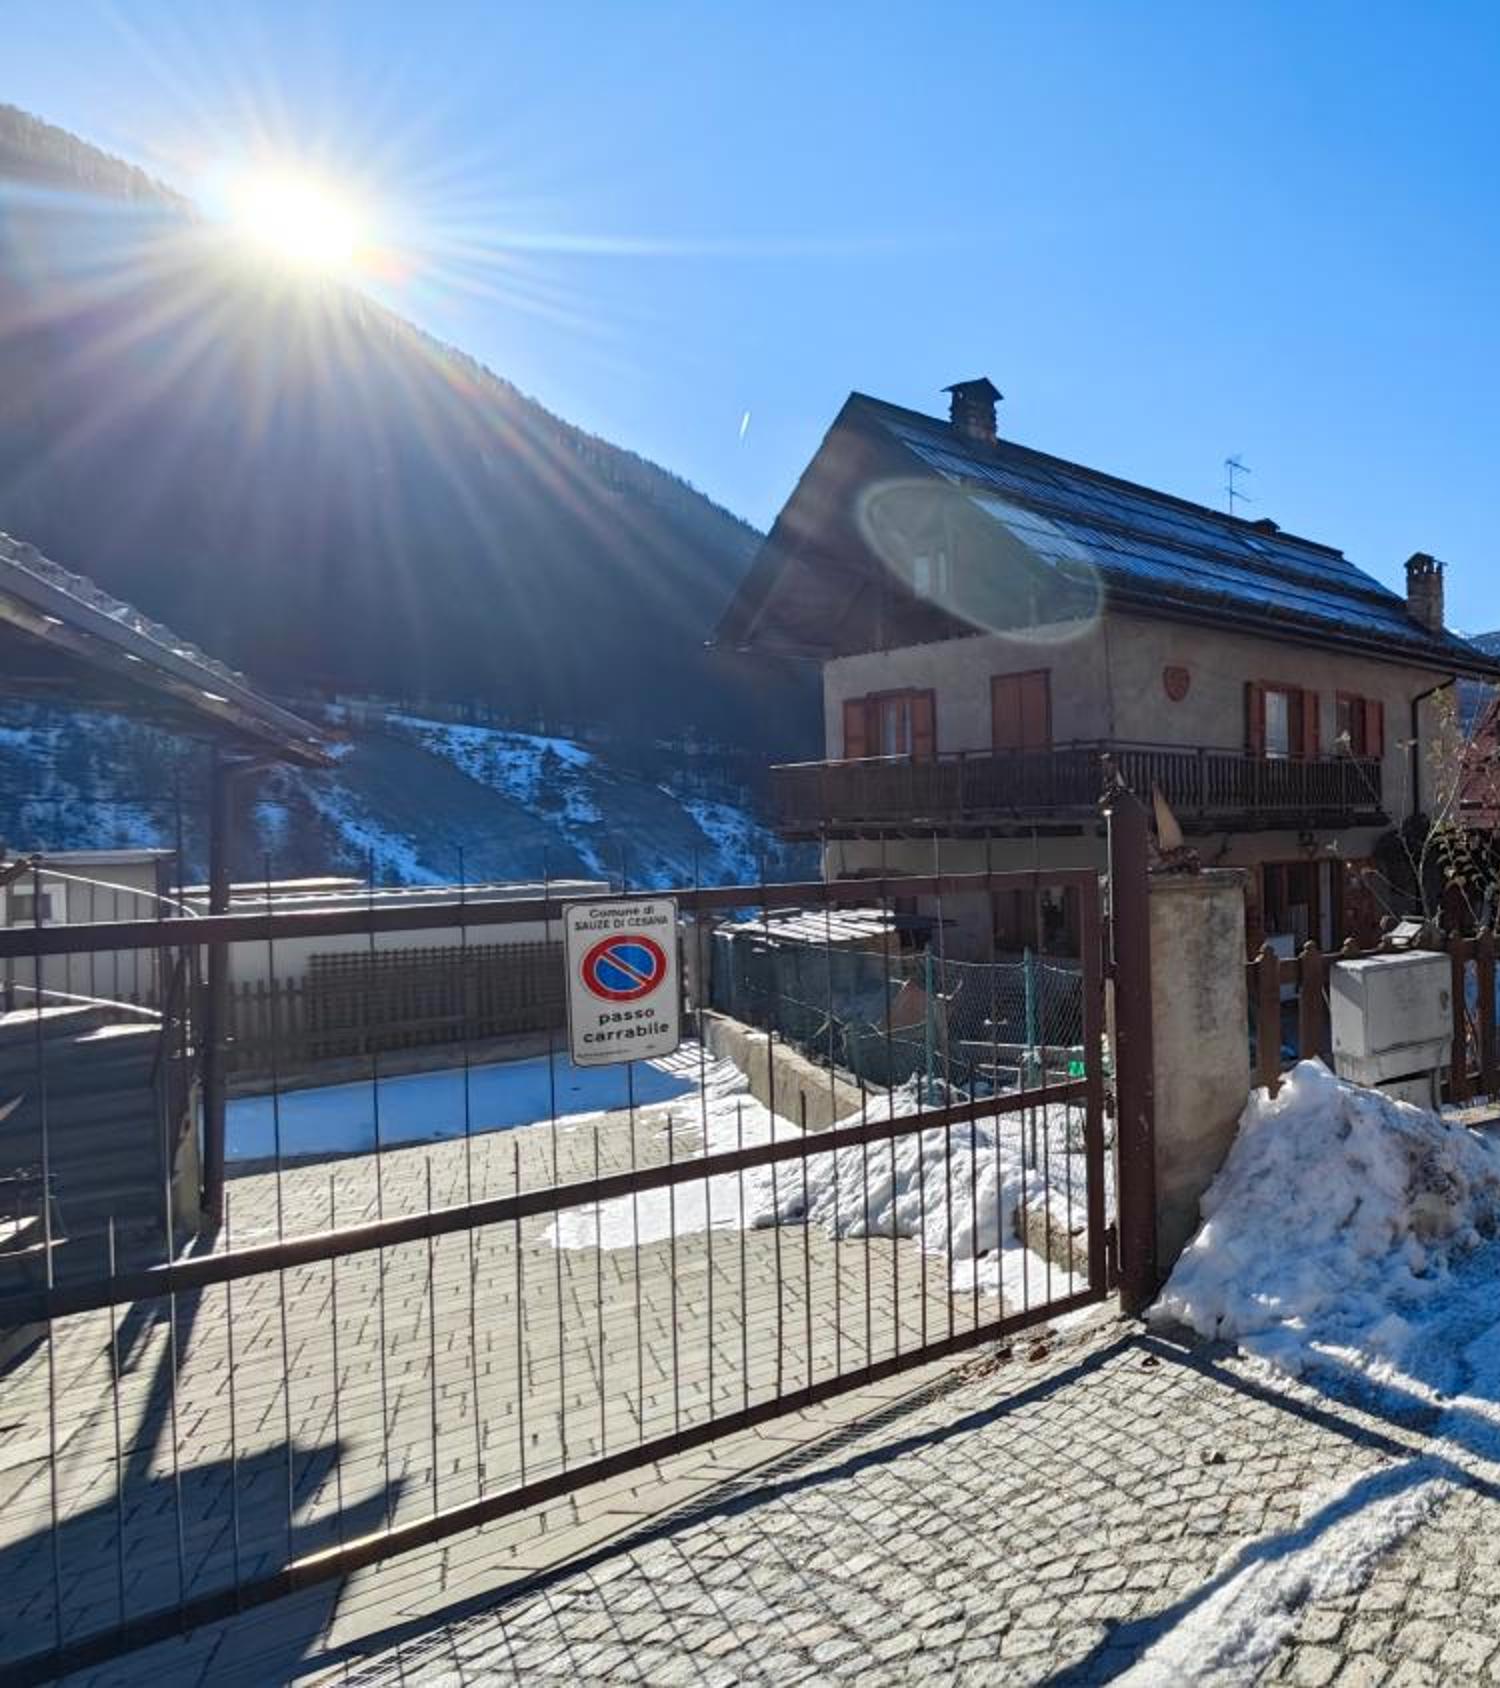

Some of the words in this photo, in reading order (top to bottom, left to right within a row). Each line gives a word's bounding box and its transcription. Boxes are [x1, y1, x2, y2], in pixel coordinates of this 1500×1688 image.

[589, 907, 640, 918] Comune
[643, 905, 654, 915] di
[575, 919, 610, 930] SAUZE
[613, 919, 625, 929] DI
[627, 915, 668, 927] CESANA
[599, 1008, 655, 1026] passo
[583, 1022, 669, 1043] carrabile
